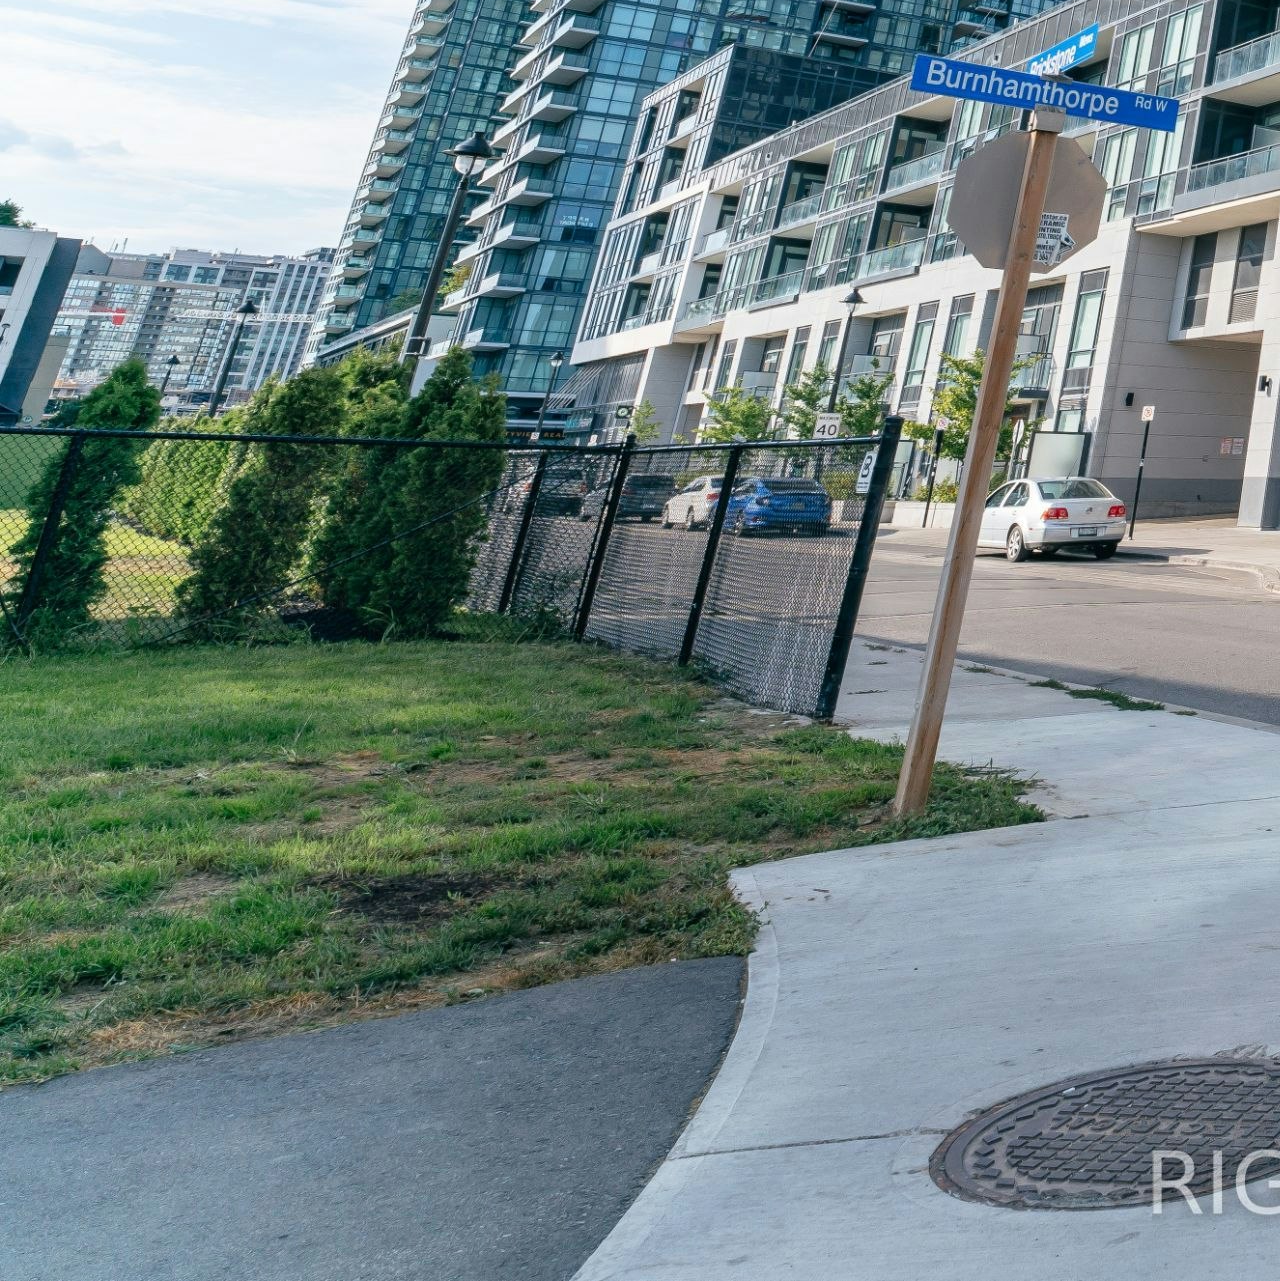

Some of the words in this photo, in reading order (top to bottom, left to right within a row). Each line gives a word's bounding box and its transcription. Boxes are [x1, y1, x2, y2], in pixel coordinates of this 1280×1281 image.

[926, 59, 1119, 117] Burnhamthorpe
[1135, 96, 1152, 109] Rd
[1155, 99, 1169, 112] W
[817, 424, 837, 436] 40
